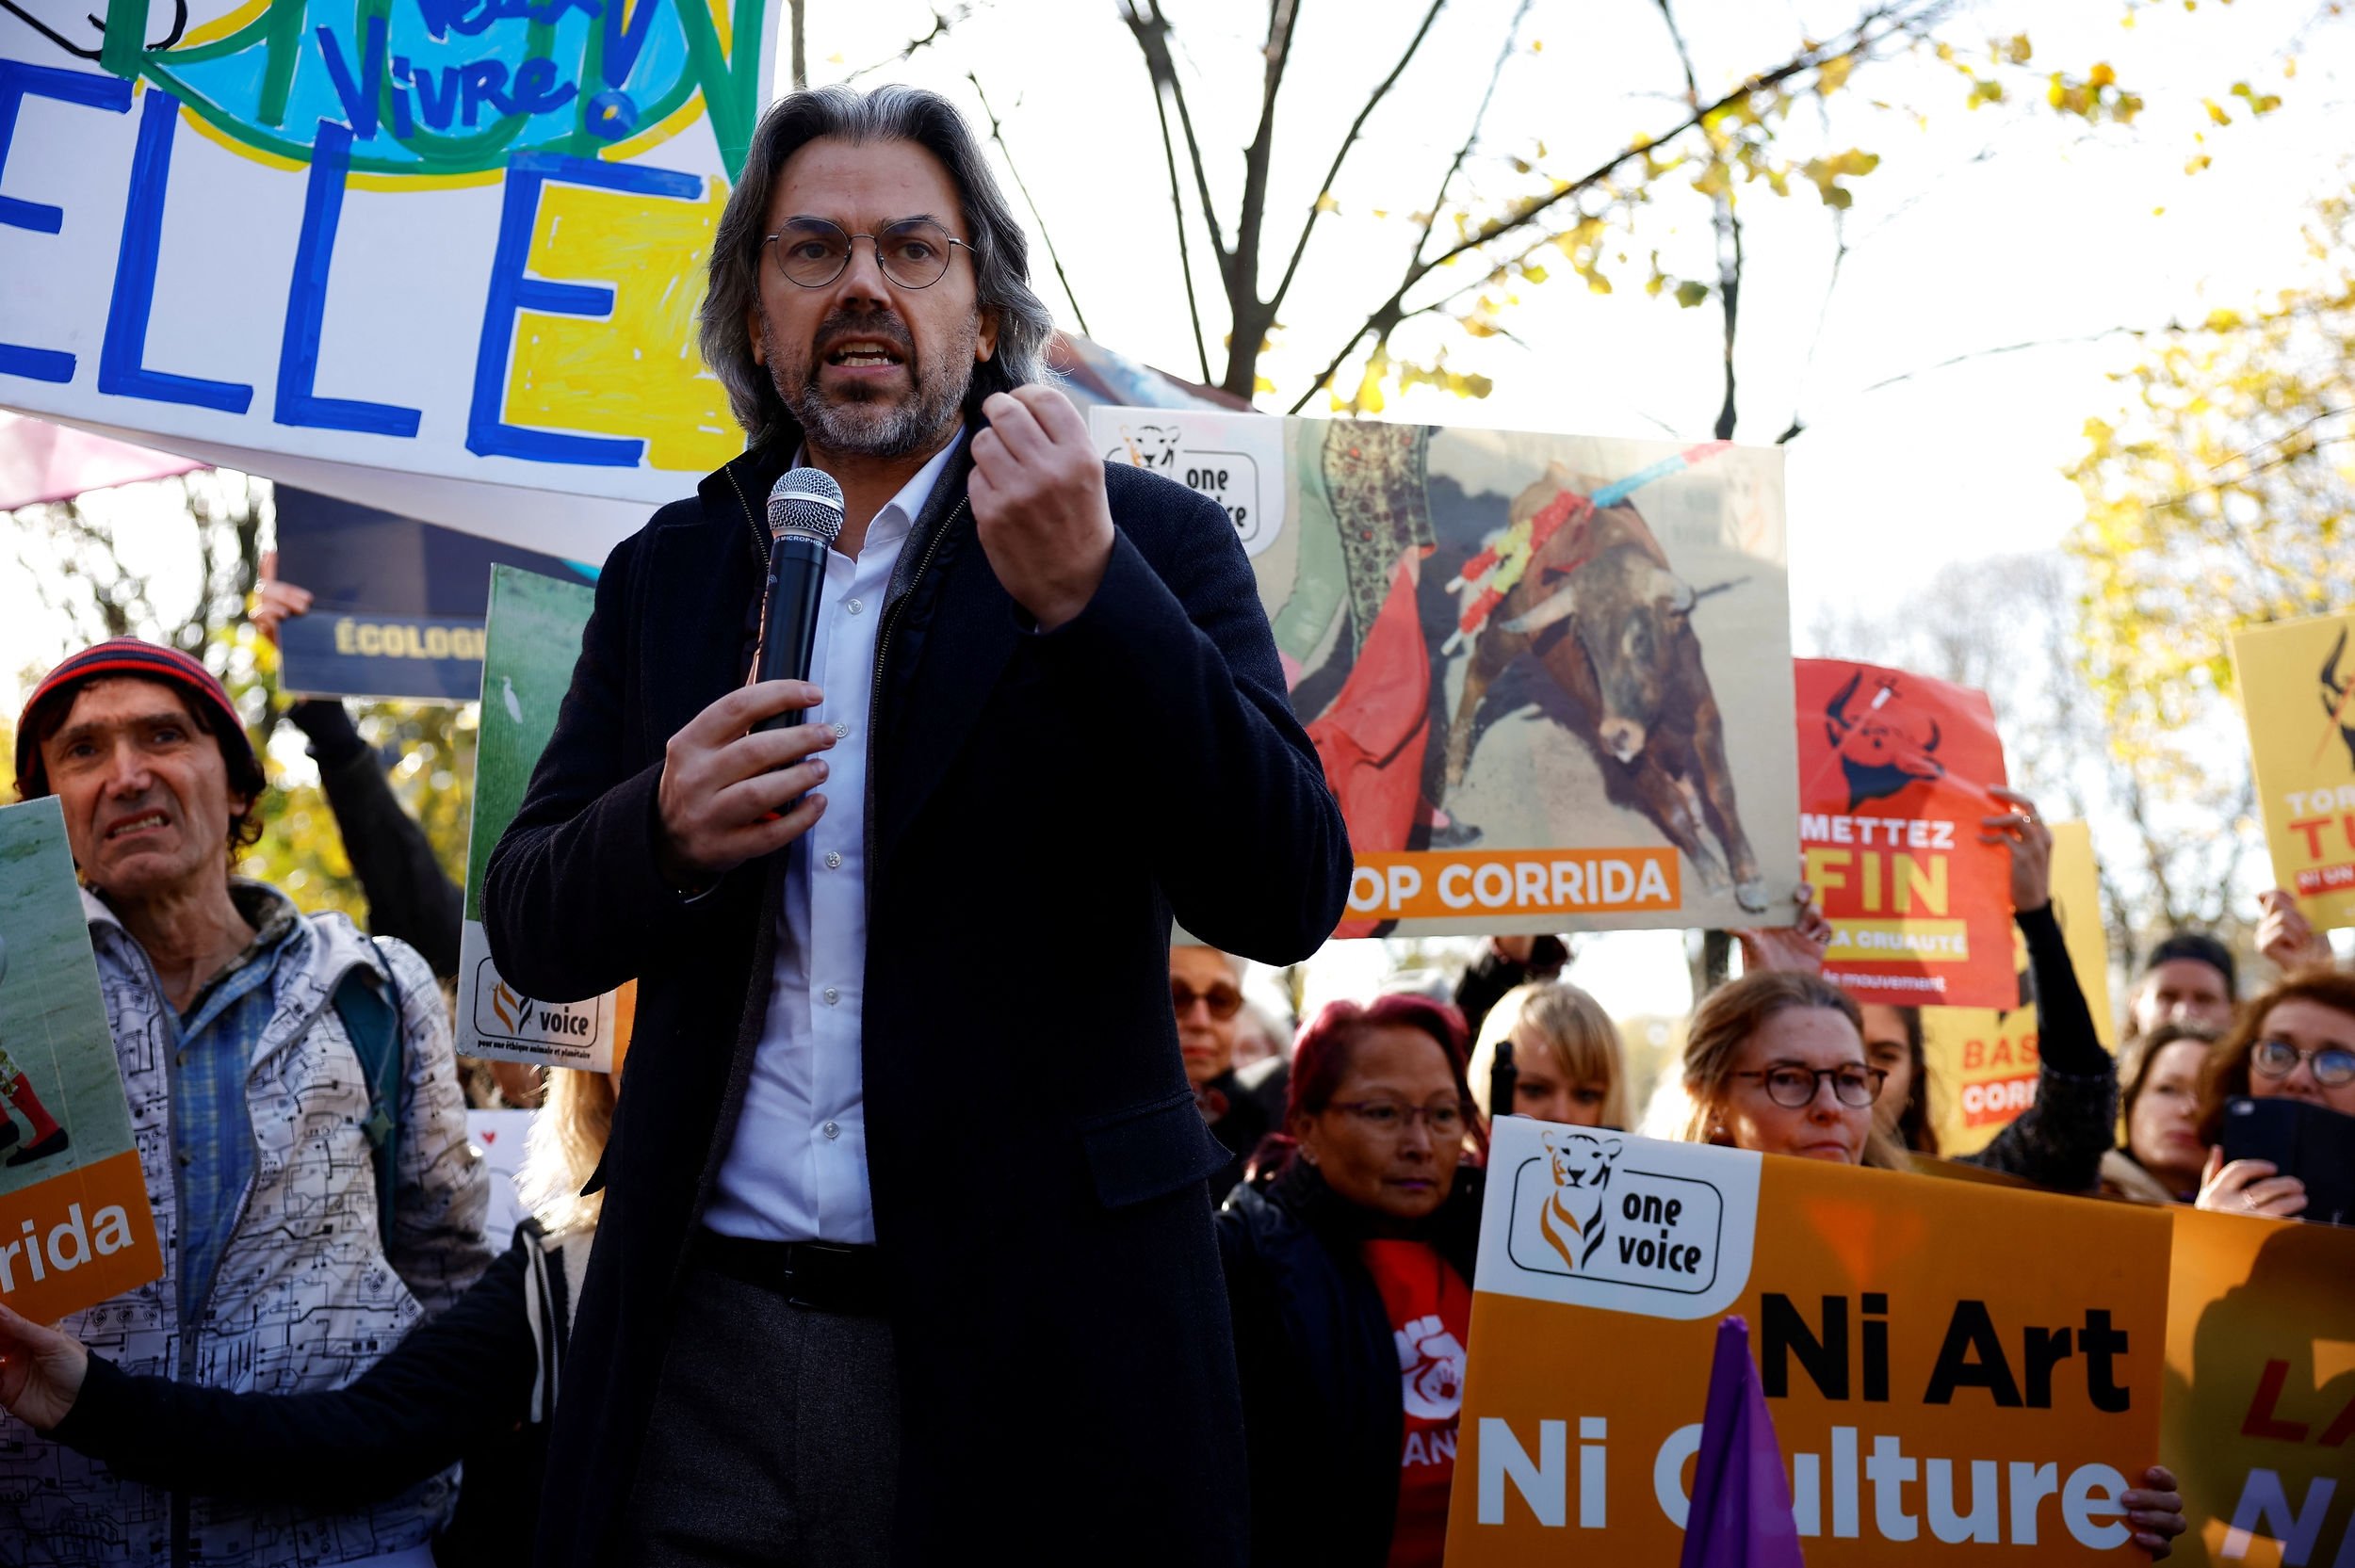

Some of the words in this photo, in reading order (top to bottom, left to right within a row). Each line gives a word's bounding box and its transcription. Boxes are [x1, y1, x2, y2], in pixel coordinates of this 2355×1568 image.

[0, 58, 703, 468] ELLE
[1186, 468, 1228, 490] one
[1800, 813, 1955, 849] METTEZ
[1437, 858, 1671, 910] CORRIDA
[1806, 848, 1948, 916] FIN
[1856, 929, 1965, 954] CRUAUTÉ
[540, 1006, 589, 1036] voice
[478, 1040, 493, 1048] pour
[494, 1041, 505, 1049] une
[506, 1041, 529, 1053] éthique
[529, 1044, 554, 1056] animale
[561, 1048, 591, 1059] planétaire
[1622, 1192, 1682, 1227] one
[0, 1203, 135, 1294] rida
[1618, 1229, 1701, 1274] voice
[1761, 1292, 1890, 1402] Ni
[1923, 1300, 2131, 1414] Art
[1477, 1415, 1607, 1529] Ni
